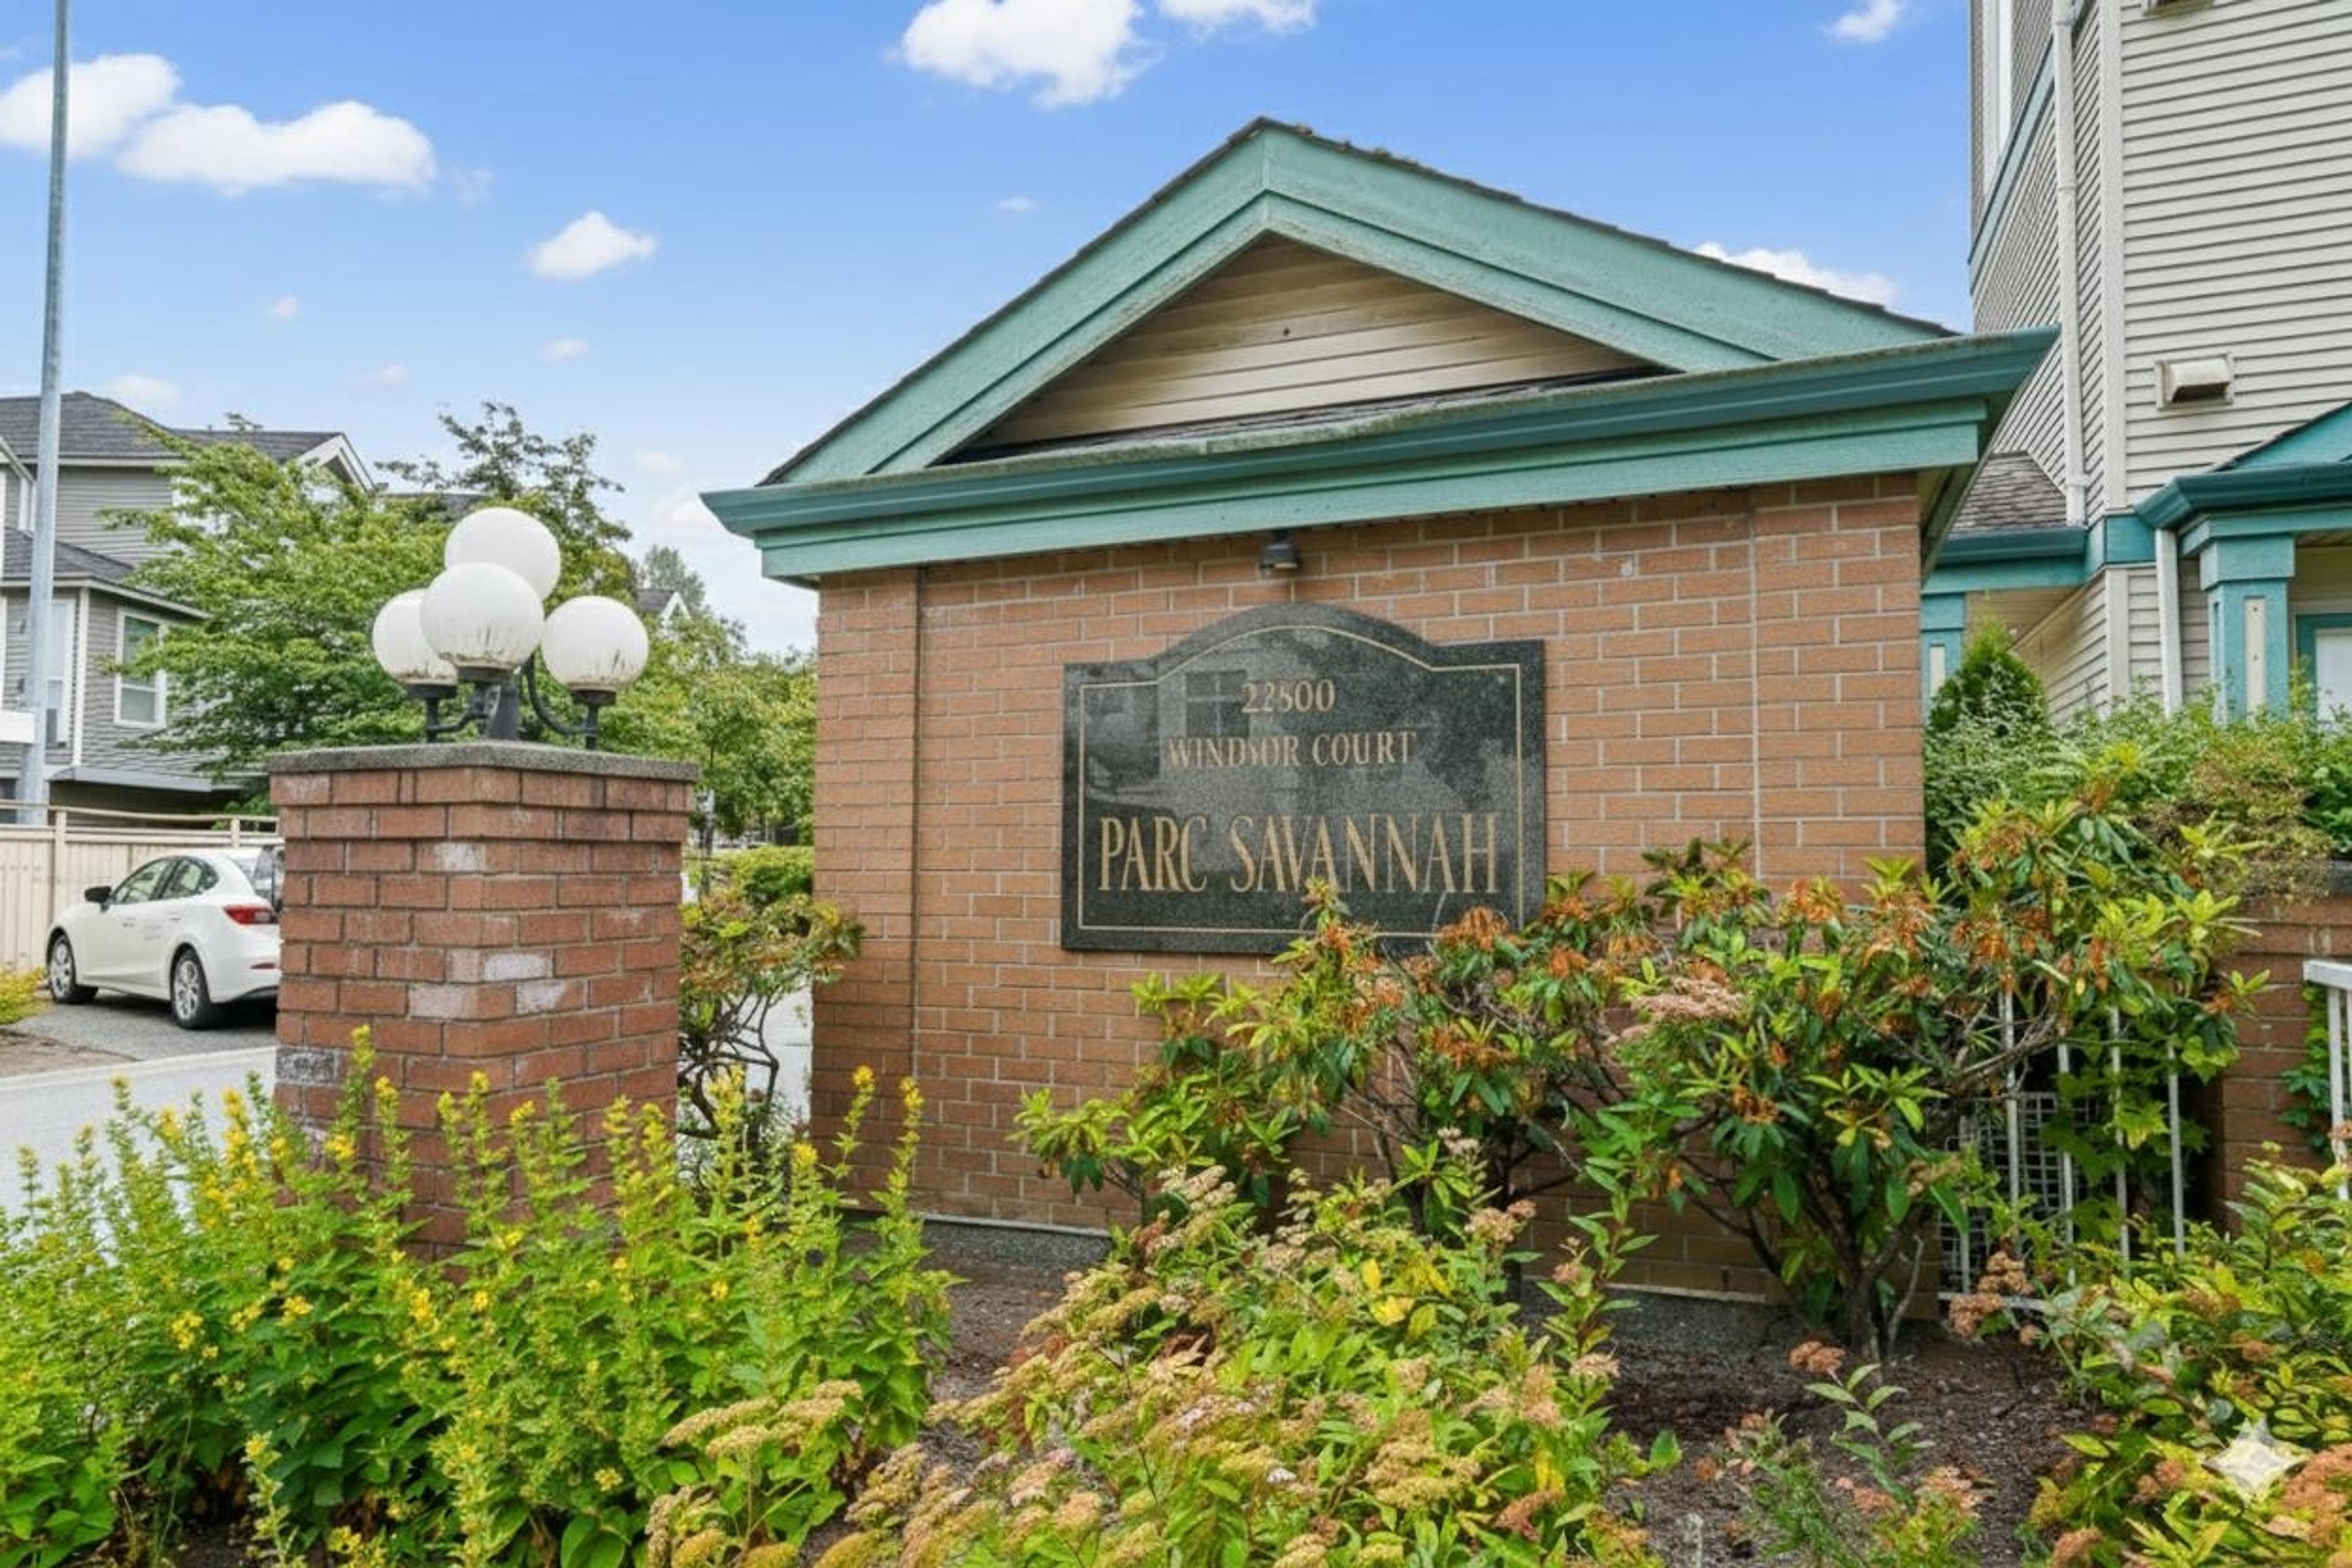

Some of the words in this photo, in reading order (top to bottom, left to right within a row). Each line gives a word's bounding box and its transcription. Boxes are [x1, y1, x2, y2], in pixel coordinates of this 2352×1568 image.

[1167, 735, 1300, 769] WINDSOR
[1311, 731, 1417, 766] COURT
[1098, 815, 1208, 892] PARC
[1229, 813, 1500, 893] SAVANNAH
